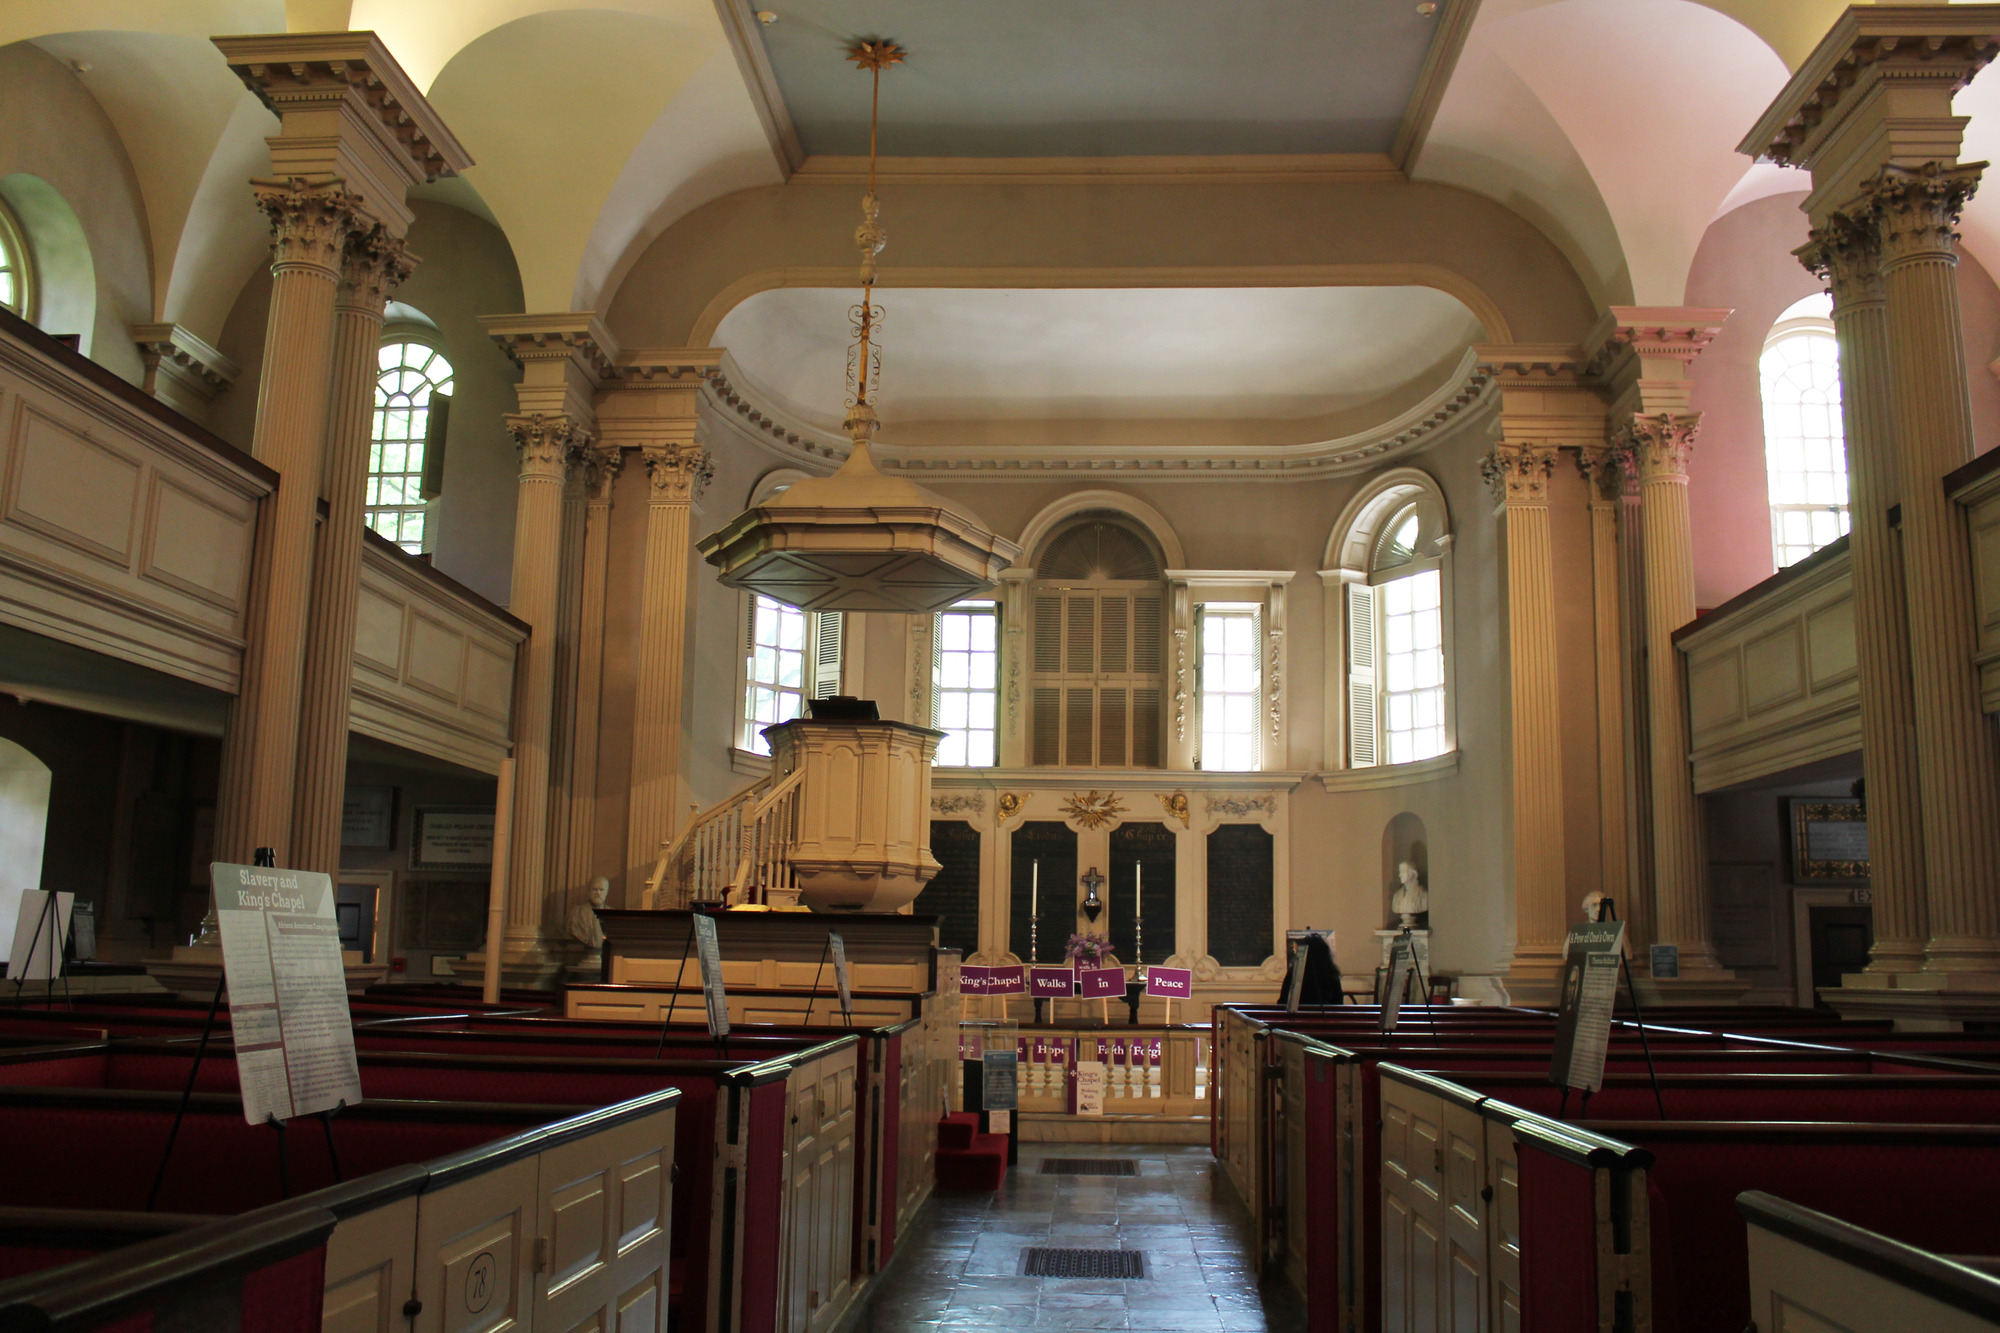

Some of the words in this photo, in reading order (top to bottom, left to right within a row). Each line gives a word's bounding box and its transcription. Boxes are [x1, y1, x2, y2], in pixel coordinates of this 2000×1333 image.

[239, 869, 279, 891] Slavery
[279, 873, 299, 890] and
[237, 890, 271, 911] King's
[271, 892, 306, 913] Chapel
[987, 975, 1021, 988] Chapel
[1036, 978, 1067, 989] Walks
[1097, 977, 1109, 989] in
[1155, 977, 1184, 989] Peace
[1077, 1070, 1098, 1079] King's
[1077, 1076, 1101, 1085] Chapel
[473, 1266, 487, 1300] 78
